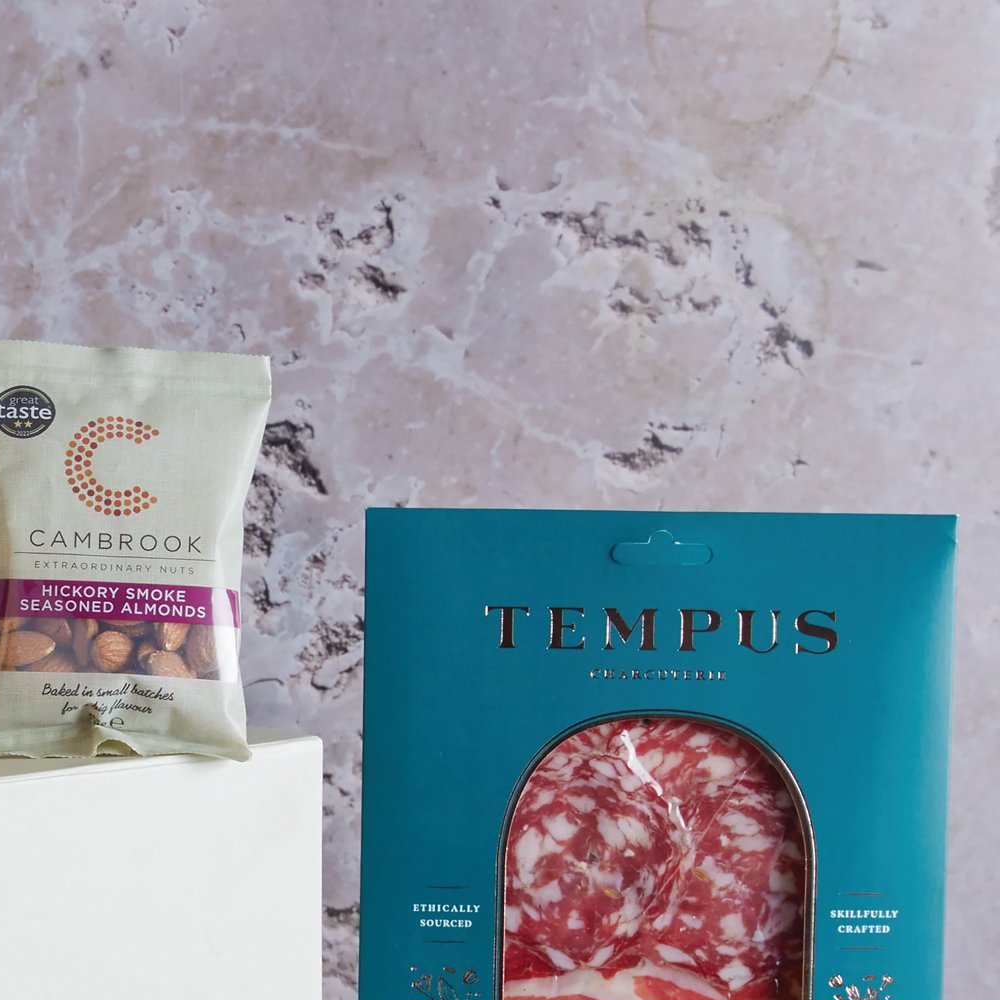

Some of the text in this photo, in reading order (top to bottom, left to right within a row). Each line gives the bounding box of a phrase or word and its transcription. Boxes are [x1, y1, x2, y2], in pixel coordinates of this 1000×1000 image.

[9, 396, 39, 406] great
[29, 529, 202, 553] CAMBROOK
[34, 560, 194, 575] EXTRAORDINARY NUTS
[42, 585, 186, 602] HICKORY SMOKE
[20, 599, 206, 618] SEASONED ALMONDS
[484, 605, 838, 655] TEMPUS
[589, 667, 727, 681] CHARCUTERIE
[42, 682, 176, 701] Baked in small batches
[61, 701, 78, 715] for
[109, 699, 153, 714] flavour
[413, 903, 480, 913] ETHICALLY
[830, 909, 899, 919] SKILLFULLY
[420, 919, 473, 928] SOURCED
[837, 925, 891, 934] CRAFTED
